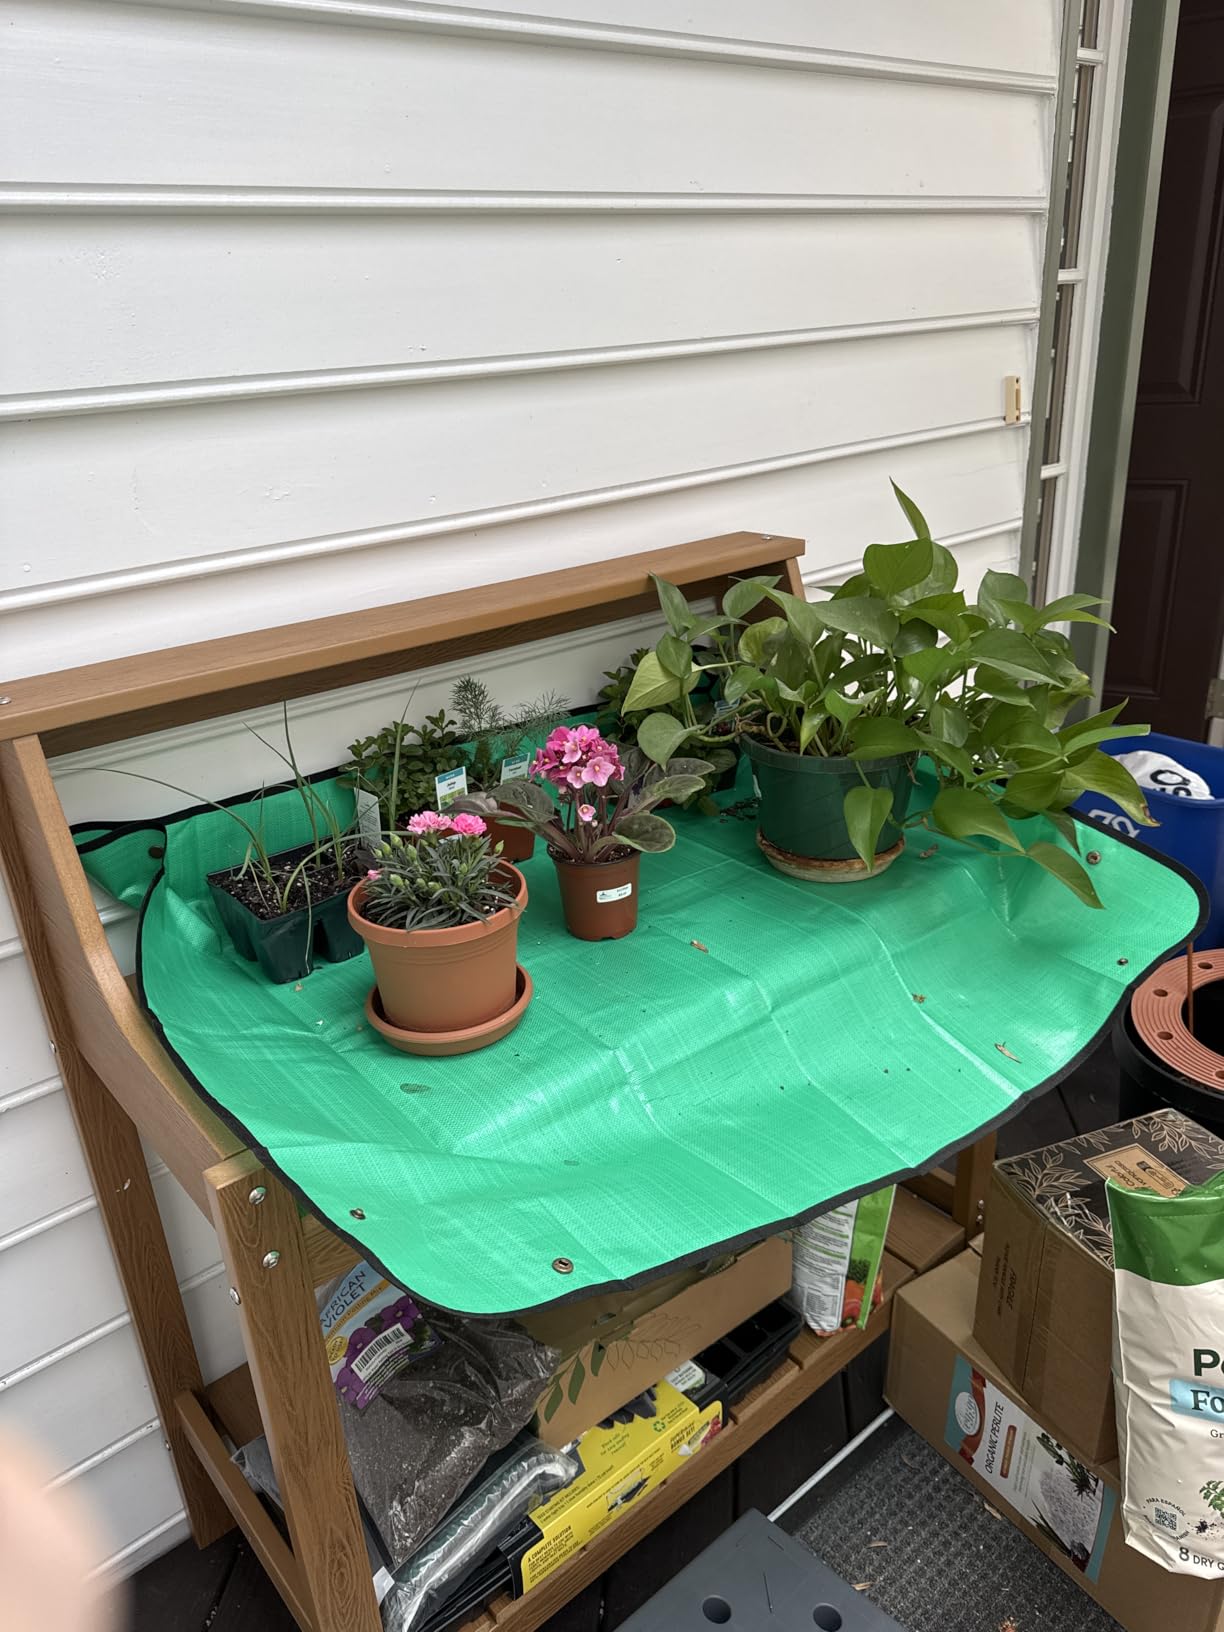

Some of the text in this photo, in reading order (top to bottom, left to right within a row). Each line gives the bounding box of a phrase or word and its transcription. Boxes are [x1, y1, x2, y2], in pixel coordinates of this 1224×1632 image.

[324, 1282, 366, 1328] VIOLET
[1193, 1348, 1224, 1376] P
[984, 1402, 1004, 1474] ORGANIC PERLITE
[531, 1540, 552, 1560] COMPLETE
[552, 1525, 572, 1544] SOLUTION
[1179, 1546, 1190, 1562] 8
[1193, 1554, 1214, 1568] DRY
